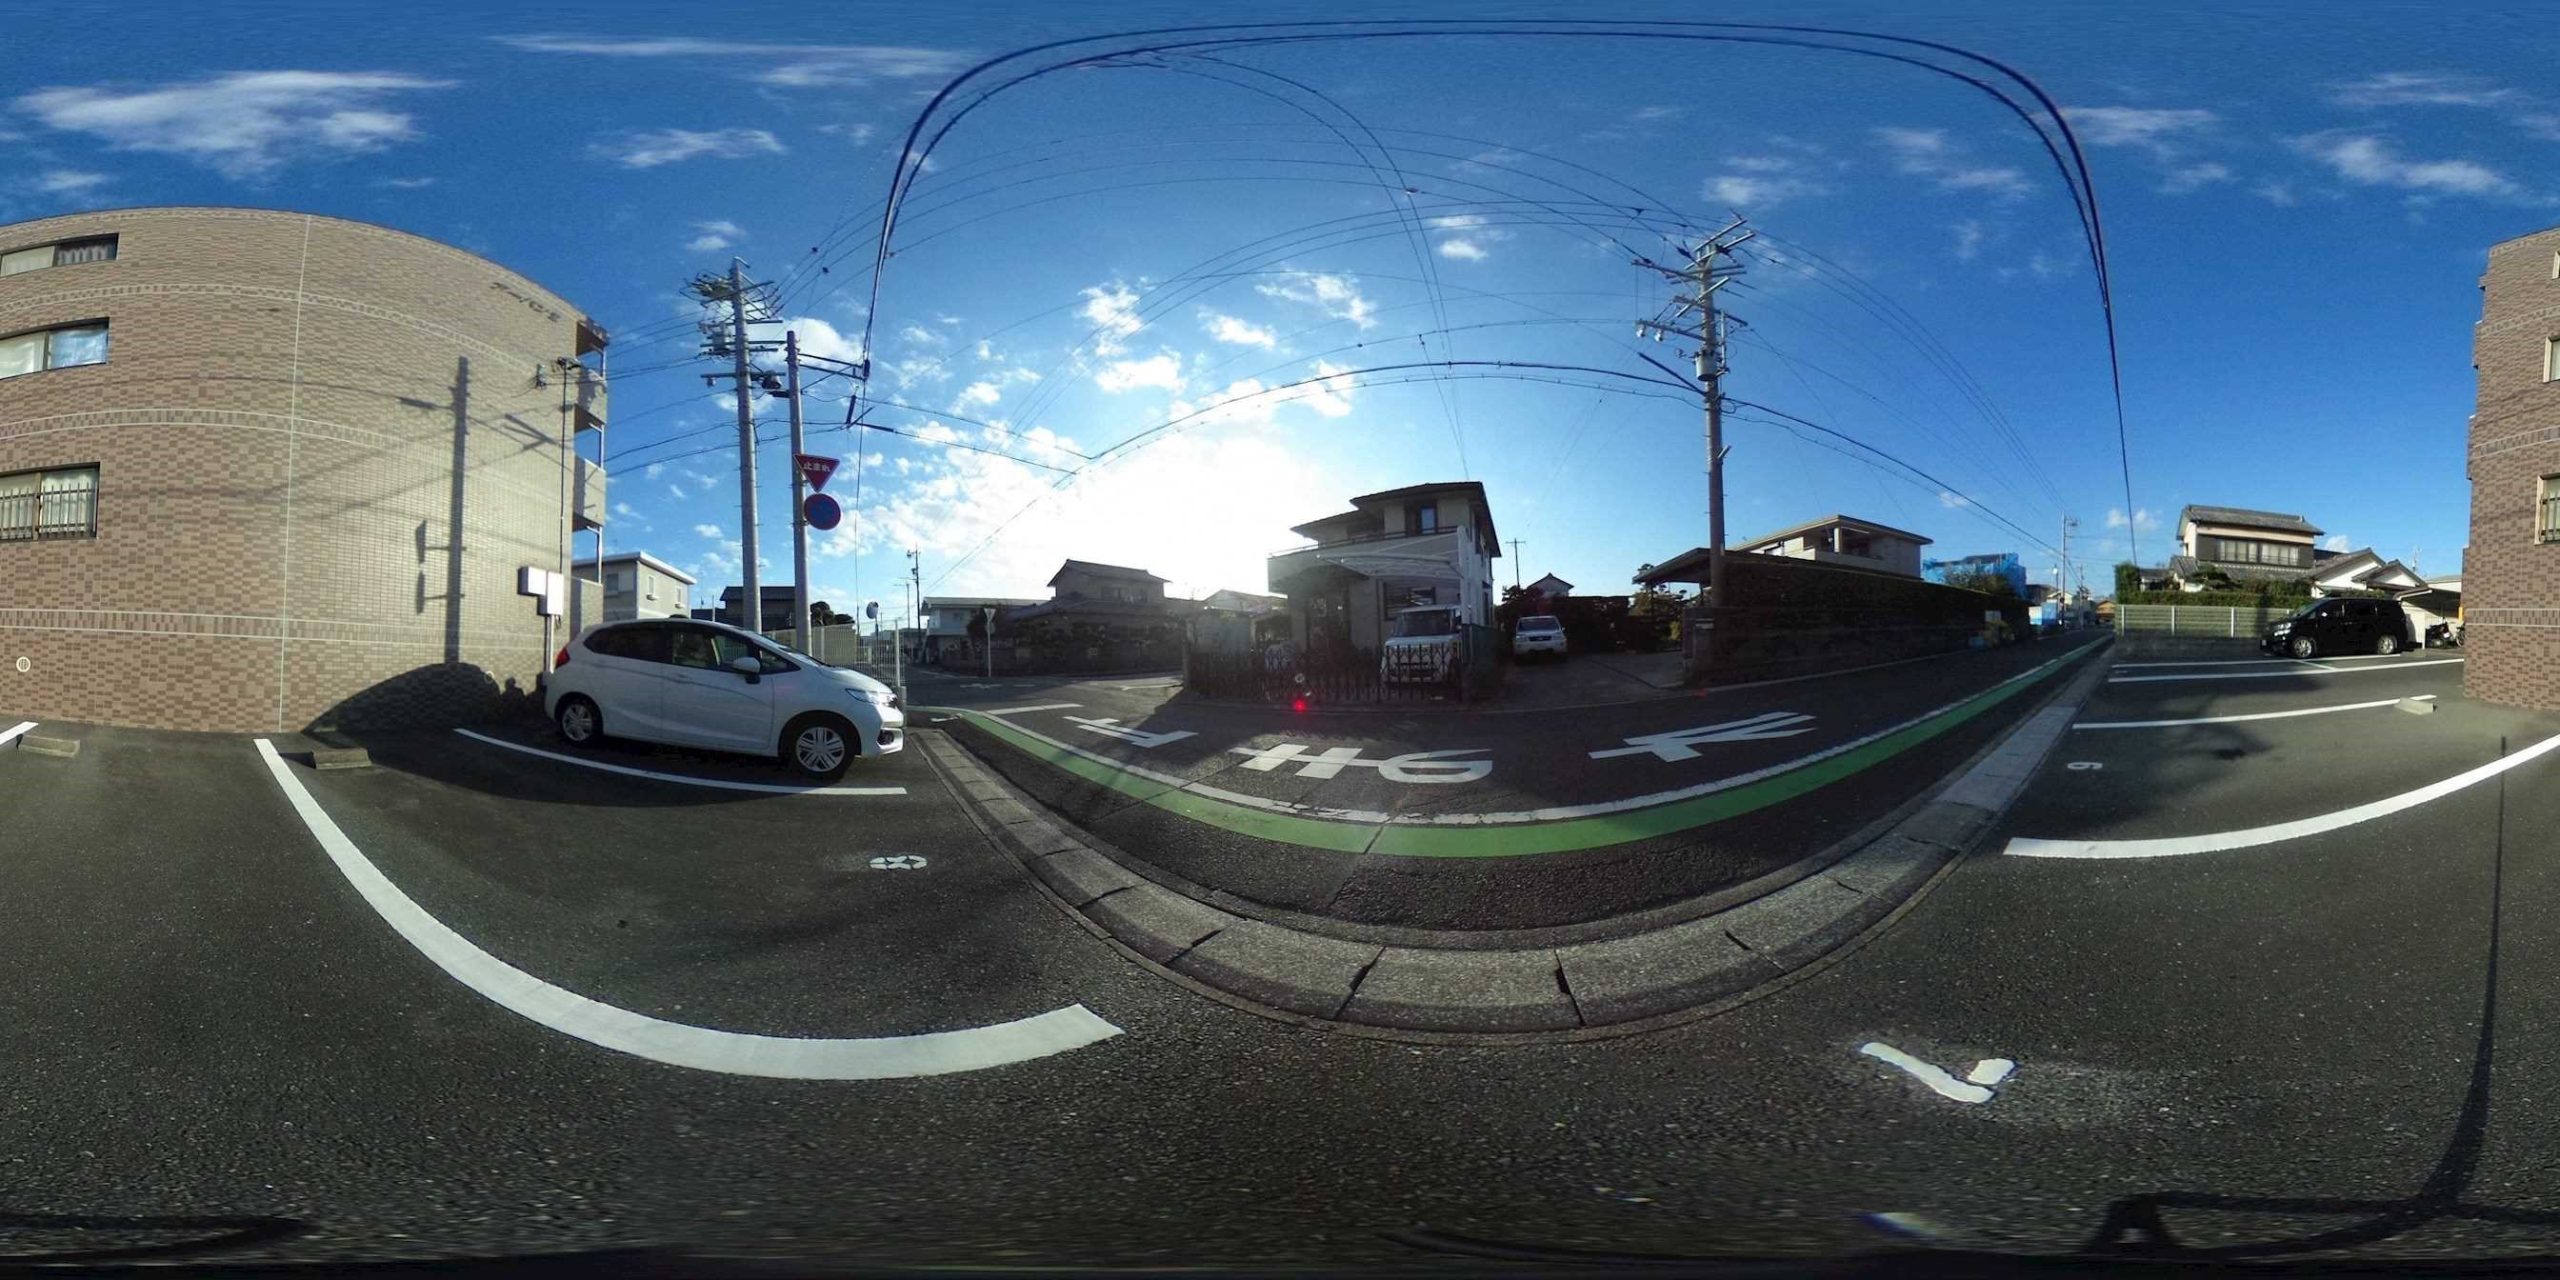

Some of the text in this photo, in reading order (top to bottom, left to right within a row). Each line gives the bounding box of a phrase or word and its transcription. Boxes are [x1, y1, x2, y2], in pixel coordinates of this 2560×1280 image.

[803, 462, 831, 472] 止まれ
[2067, 761, 2103, 770] 6
[869, 855, 928, 870] 8
